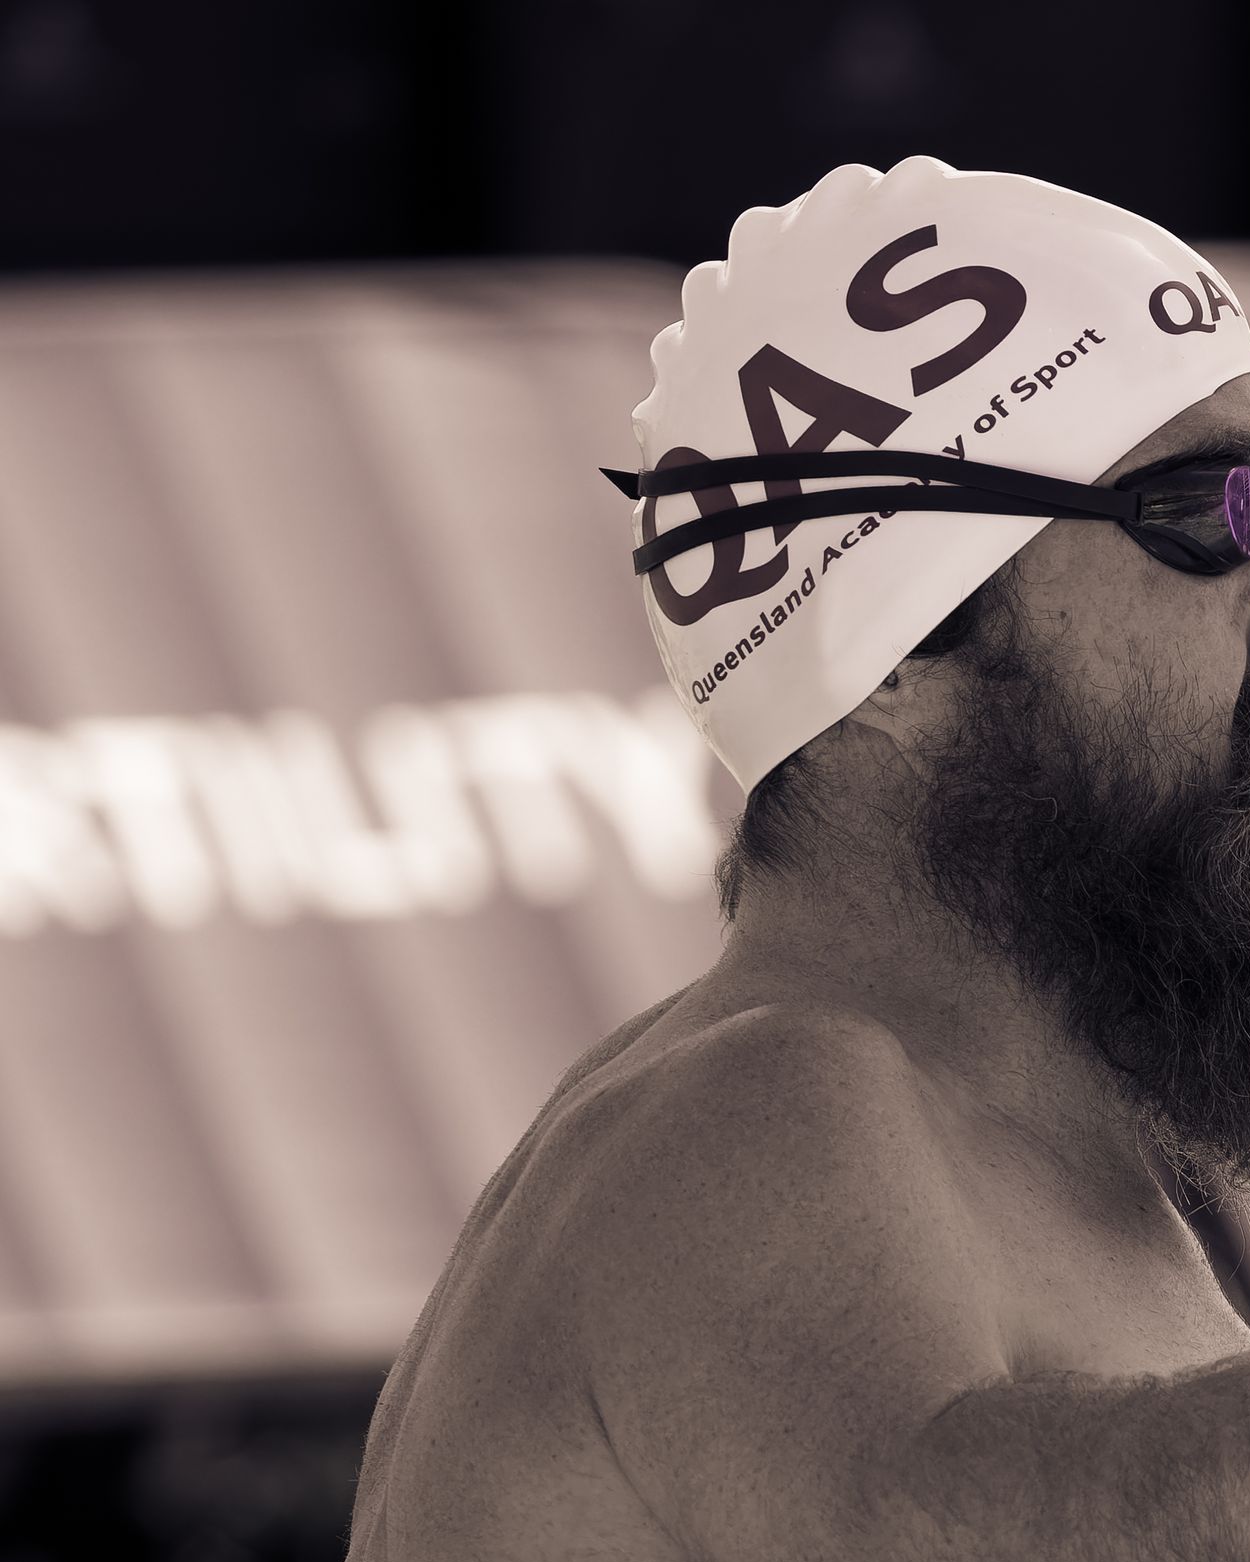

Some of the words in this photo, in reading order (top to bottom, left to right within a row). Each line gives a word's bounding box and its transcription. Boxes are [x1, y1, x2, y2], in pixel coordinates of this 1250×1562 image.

[642, 224, 1027, 627] QAS
[1148, 271, 1244, 335] QA
[691, 567, 816, 705] Queensland
[822, 434, 965, 575] Acay
[972, 394, 1010, 434] of
[1010, 327, 1106, 402] Sport
